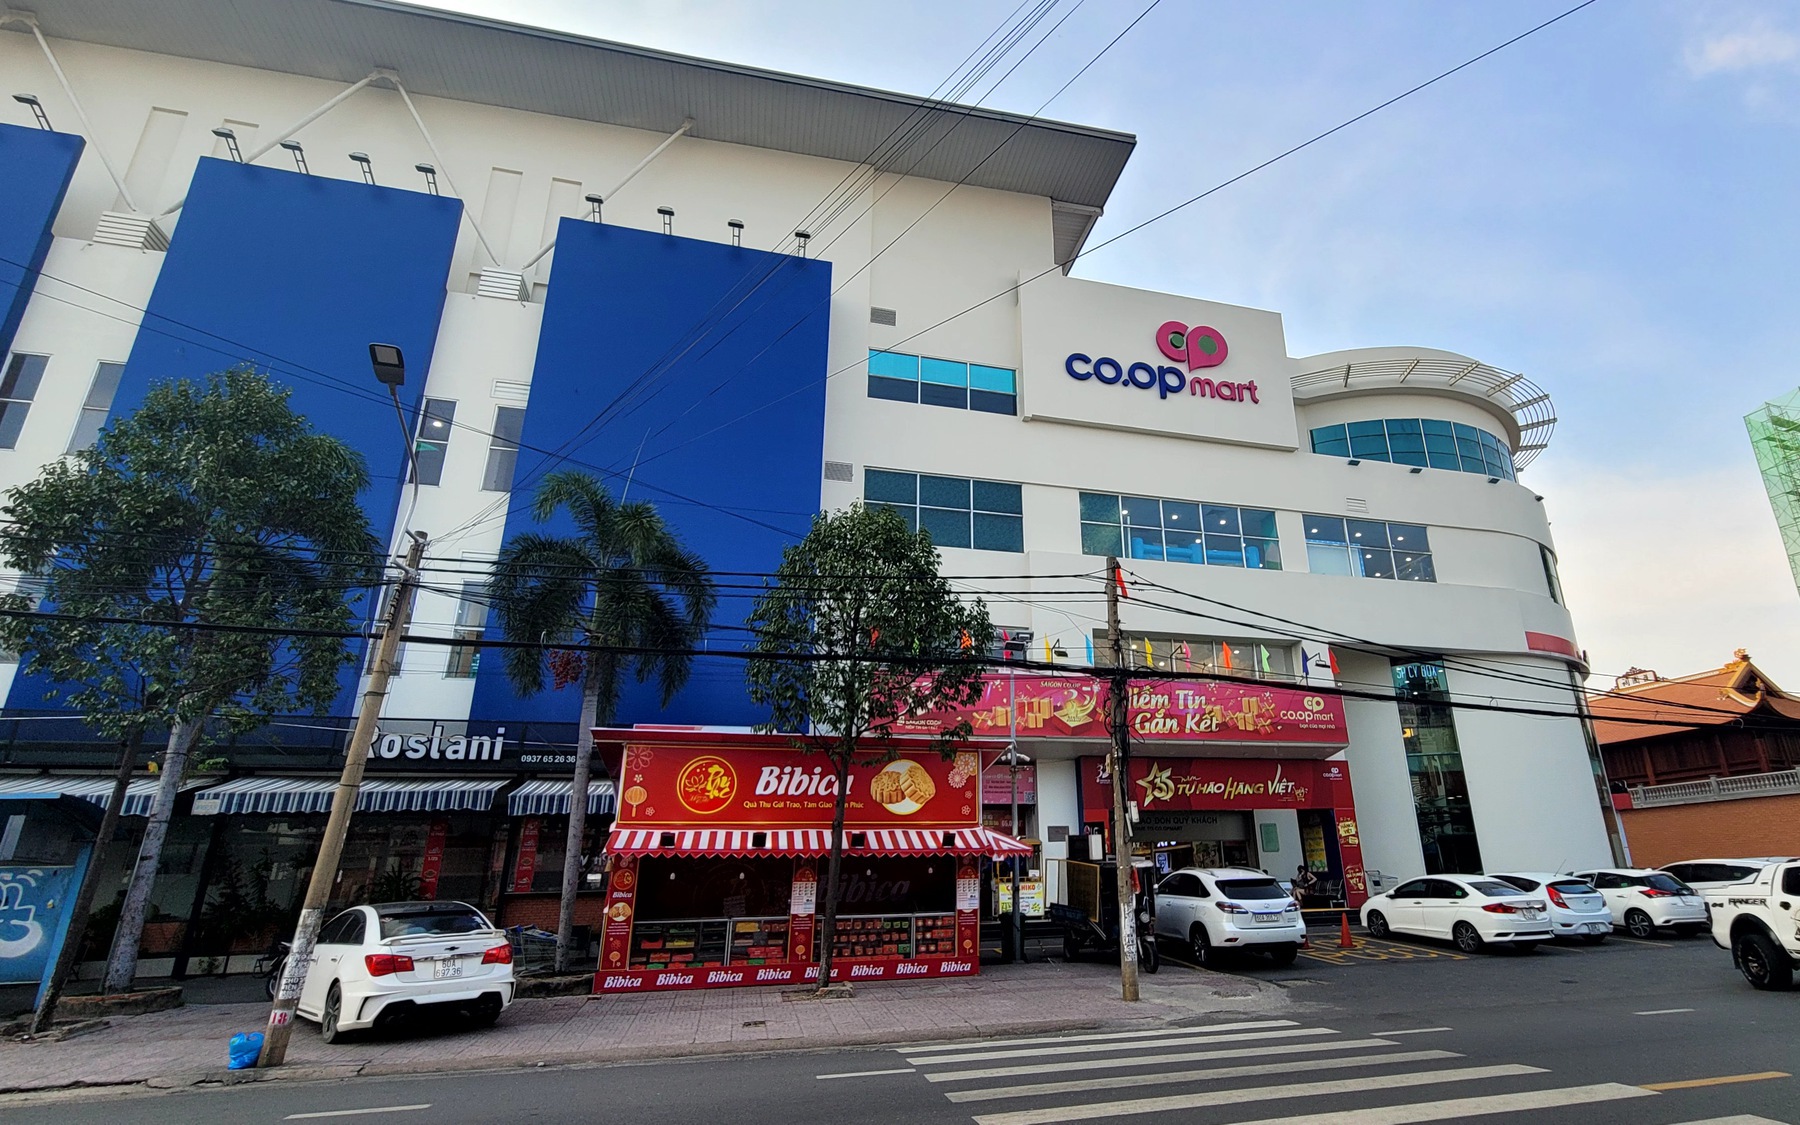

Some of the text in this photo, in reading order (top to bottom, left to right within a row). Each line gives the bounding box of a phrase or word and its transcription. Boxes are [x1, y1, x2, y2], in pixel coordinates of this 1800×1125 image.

[1040, 680, 1061, 688] SAIGON
[1175, 689, 1207, 710] Tin
[1135, 708, 1219, 734] Gắn Kết
[520, 754, 576, 763] 0937 65 26 36
[1177, 783, 1196, 797] TỰ
[1267, 763, 1295, 796] VIỆT
[1727, 897, 1771, 909] RANGER
[850, 964, 884, 977] Bibica
[896, 963, 928, 975] Bibica
[940, 961, 972, 973] Bibica
[656, 973, 694, 986] Bibica
[707, 969, 743, 985] Bibica
[756, 967, 792, 982] Bibica
[604, 975, 642, 989] Bibica
[272, 1012, 288, 1025] 18
